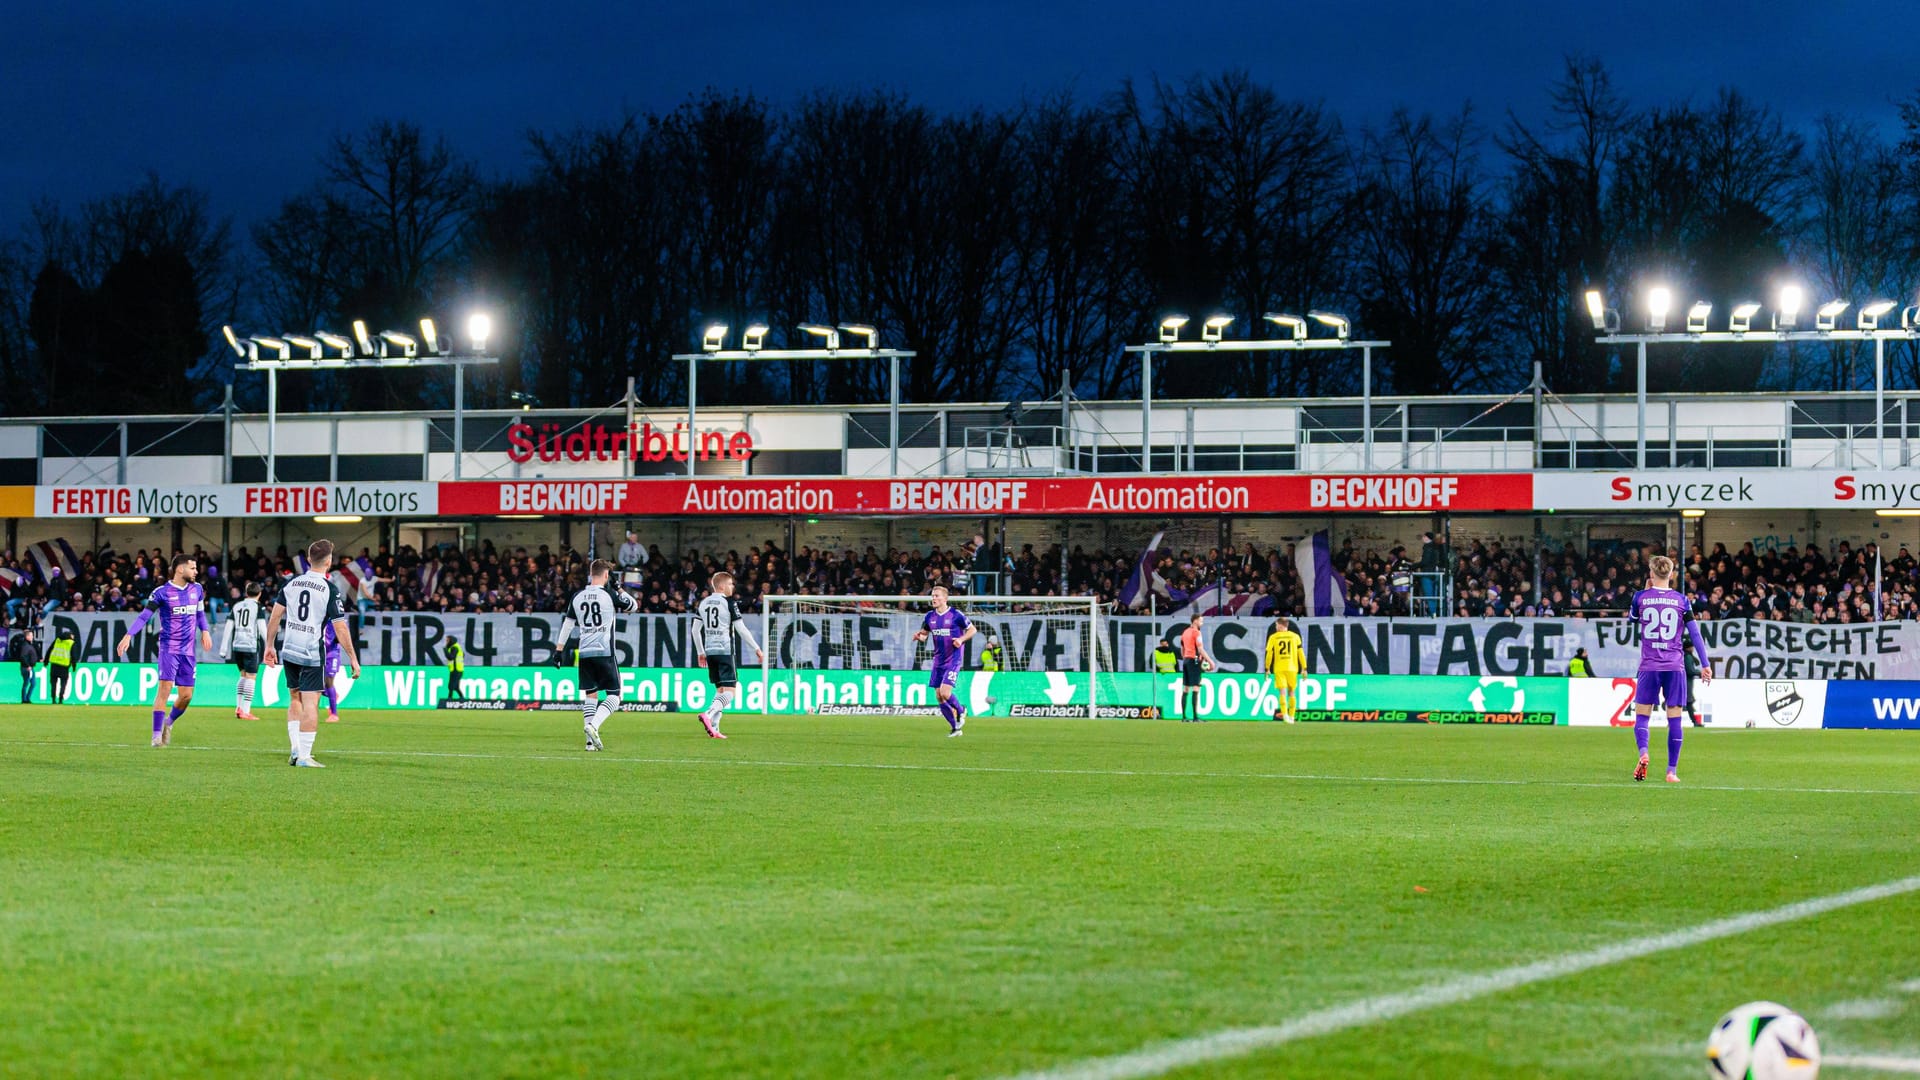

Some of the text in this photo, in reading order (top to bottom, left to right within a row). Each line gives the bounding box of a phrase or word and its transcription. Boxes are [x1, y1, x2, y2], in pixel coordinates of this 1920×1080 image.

[505, 423, 753, 463] Südtribüne
[52, 488, 218, 514] FERTIG Motors
[245, 486, 418, 513] FERTIG Motors
[500, 481, 833, 511] BECKHOFF Automation
[890, 479, 1249, 510] BECKHOFF Automation
[1310, 477, 1458, 508] BECKHOFF
[1611, 476, 1753, 508] Smyczek
[238, 608, 250, 628] 10
[298, 590, 310, 622] 8
[580, 601, 602, 627] 28
[705, 606, 719, 629] 13
[1642, 607, 1679, 640] 29
[350, 614, 445, 667] FÜR
[465, 617, 498, 667] 4
[517, 615, 891, 670] BSINLICHE
[384, 670, 444, 706] Wir
[619, 671, 706, 710] Folie
[1168, 677, 1279, 717] 100%
[445, 700, 506, 710] wa-strom.de
[614, 702, 668, 713] -strom.de
[818, 703, 890, 716] Eisenbach
[1010, 704, 1084, 718] Eisenbach
[1427, 710, 1552, 725] sportnavi.de
